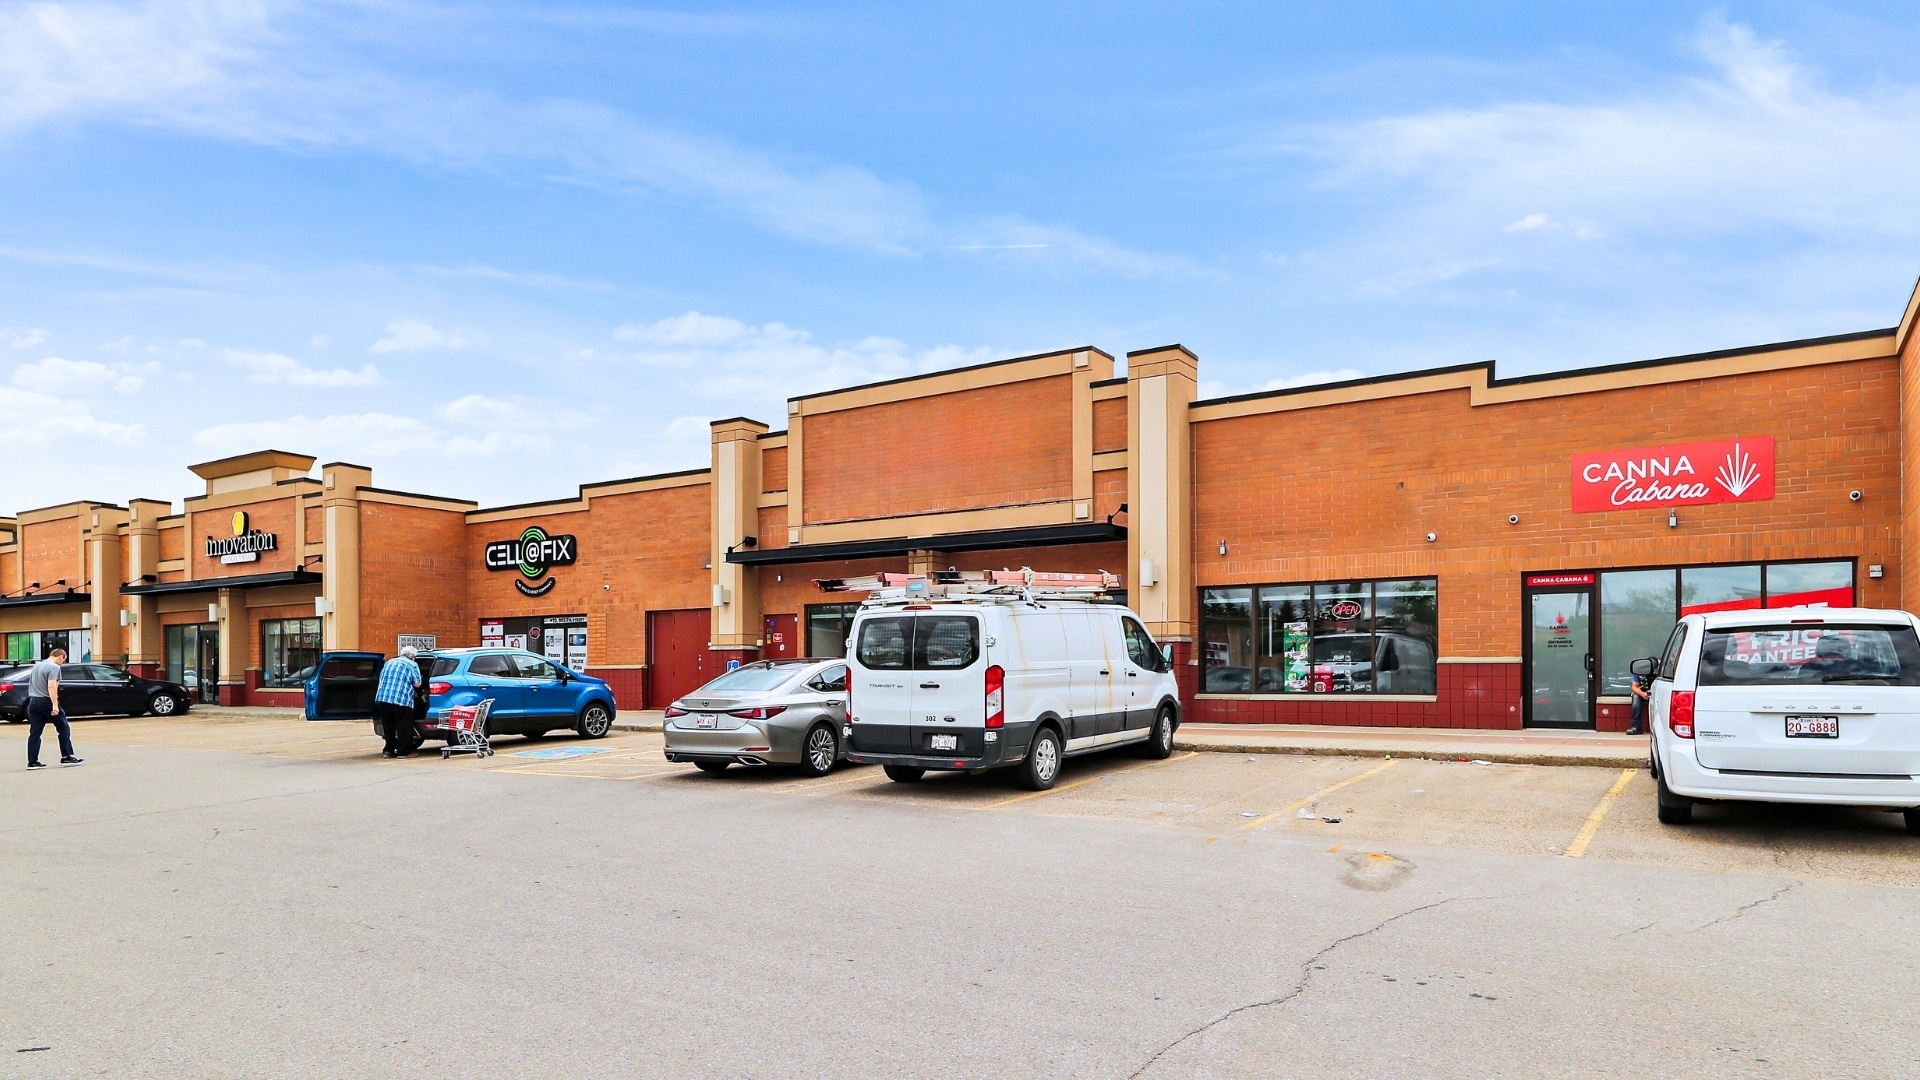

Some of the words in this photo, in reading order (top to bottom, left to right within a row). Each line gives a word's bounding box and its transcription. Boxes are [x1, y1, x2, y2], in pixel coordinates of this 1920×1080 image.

[1582, 455, 1695, 483] CANNA
[1610, 478, 1710, 506] Cabana
[205, 529, 274, 557] innovation
[1334, 605, 1359, 615] OPEN
[1788, 722, 1836, 733] 20-G888
